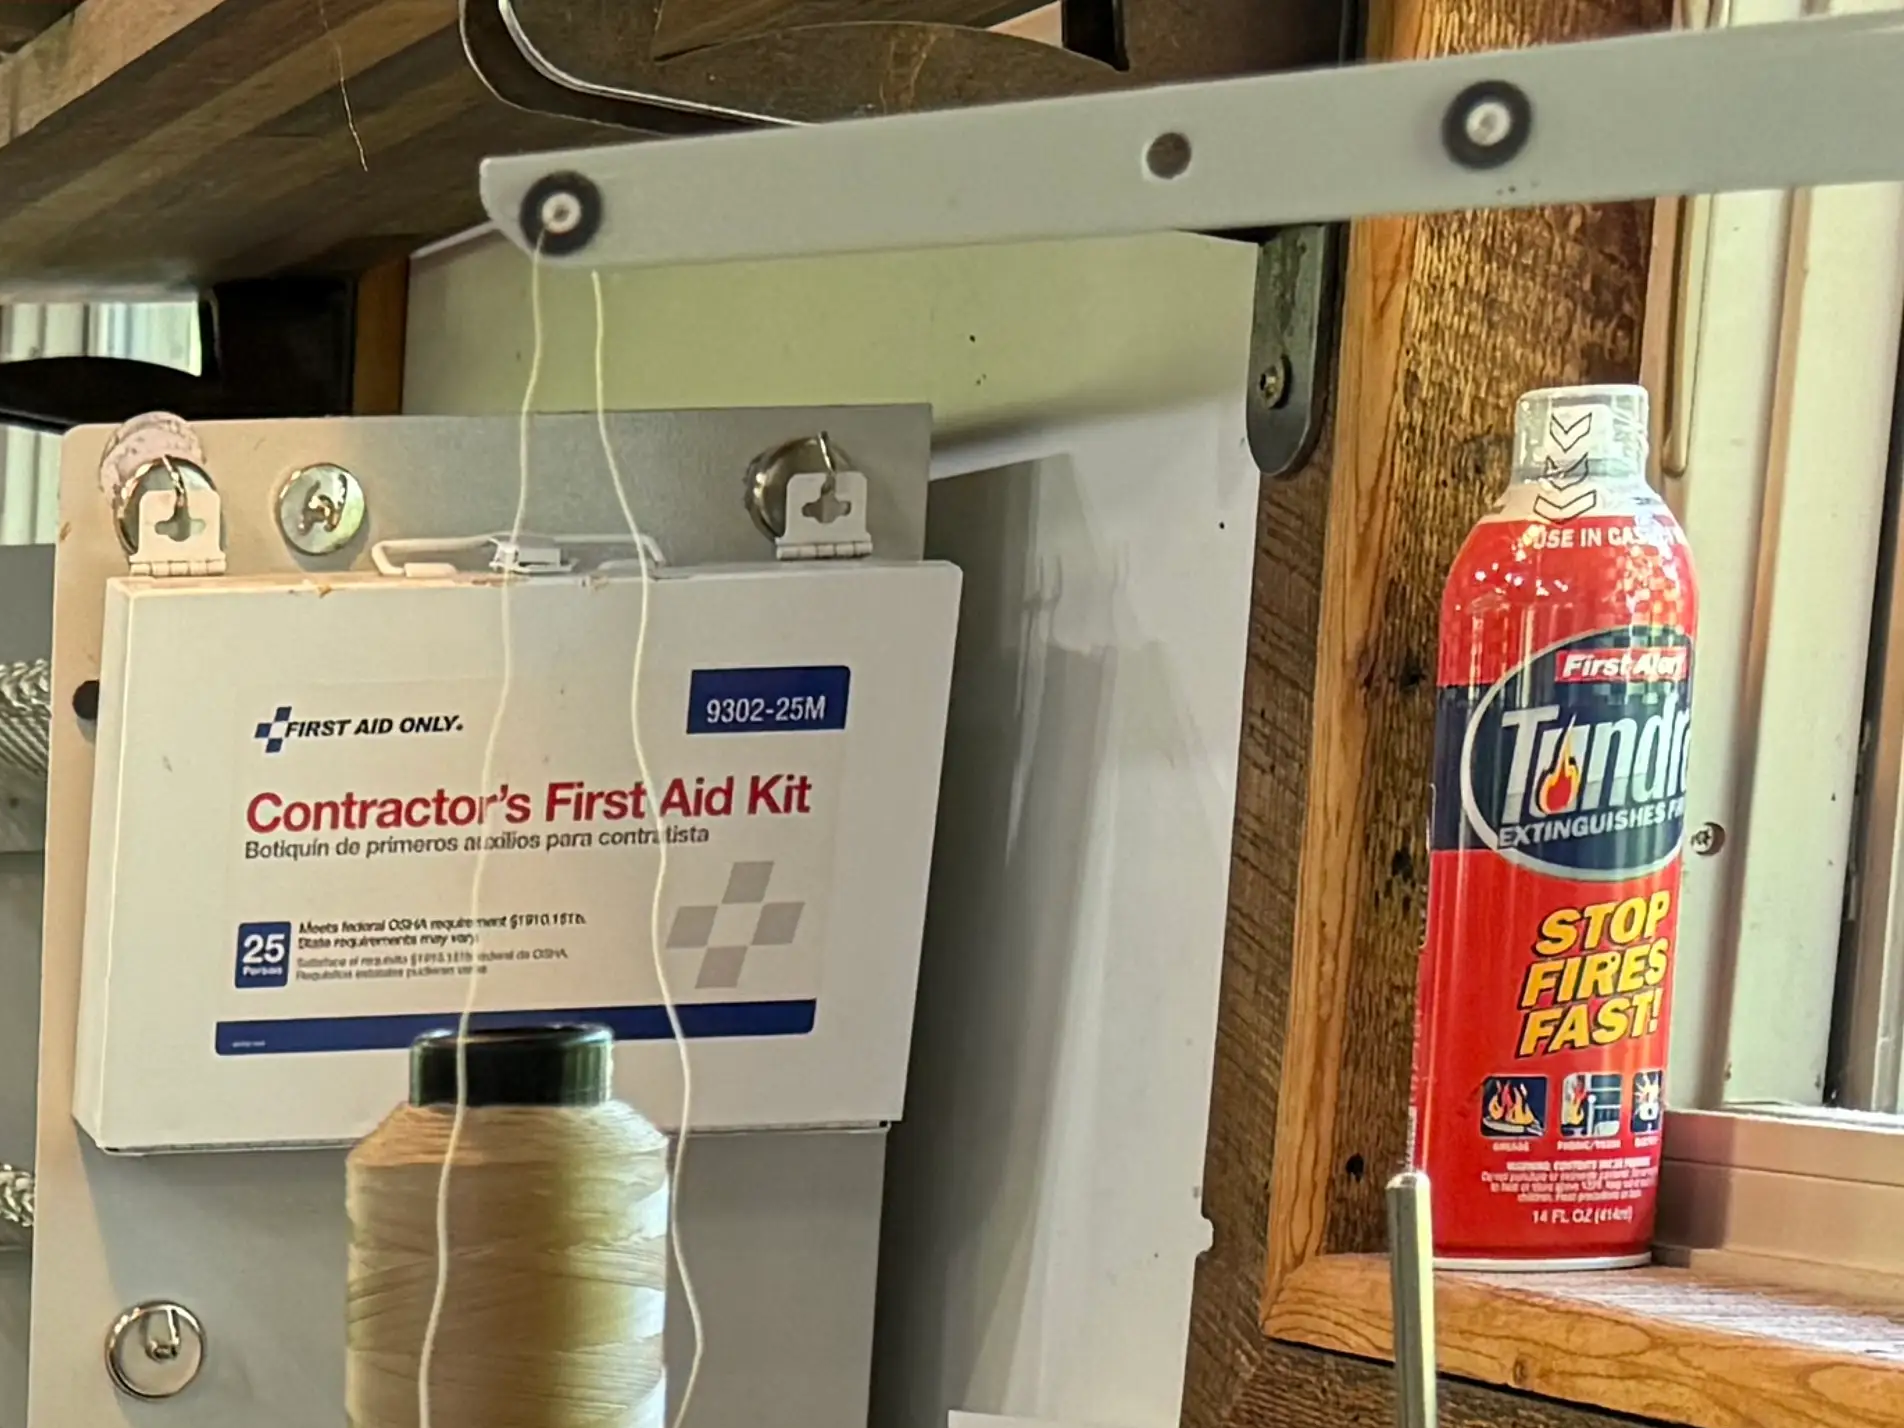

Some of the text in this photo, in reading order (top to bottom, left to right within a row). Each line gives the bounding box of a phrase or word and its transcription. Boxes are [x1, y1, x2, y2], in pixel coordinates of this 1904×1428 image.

[1580, 528, 1602, 547] IN
[1563, 653, 1629, 677] First
[706, 696, 826, 723] 9302-25M
[285, 719, 351, 738] FIRST
[354, 718, 392, 735] AID
[247, 774, 812, 833] Contractor's First Aid Kit
[1500, 803, 1666, 846] EXTINGUISHES
[245, 838, 329, 861] Botiquín
[336, 837, 360, 855] de
[366, 835, 457, 857] primeros
[546, 831, 593, 851] para
[1535, 890, 1670, 956] STOP
[242, 933, 285, 964] 25
[1519, 938, 1669, 1009] FIRES
[1516, 988, 1663, 1058] FAST!
[1533, 1211, 1547, 1224] 14
[1572, 1208, 1592, 1223] OZ
